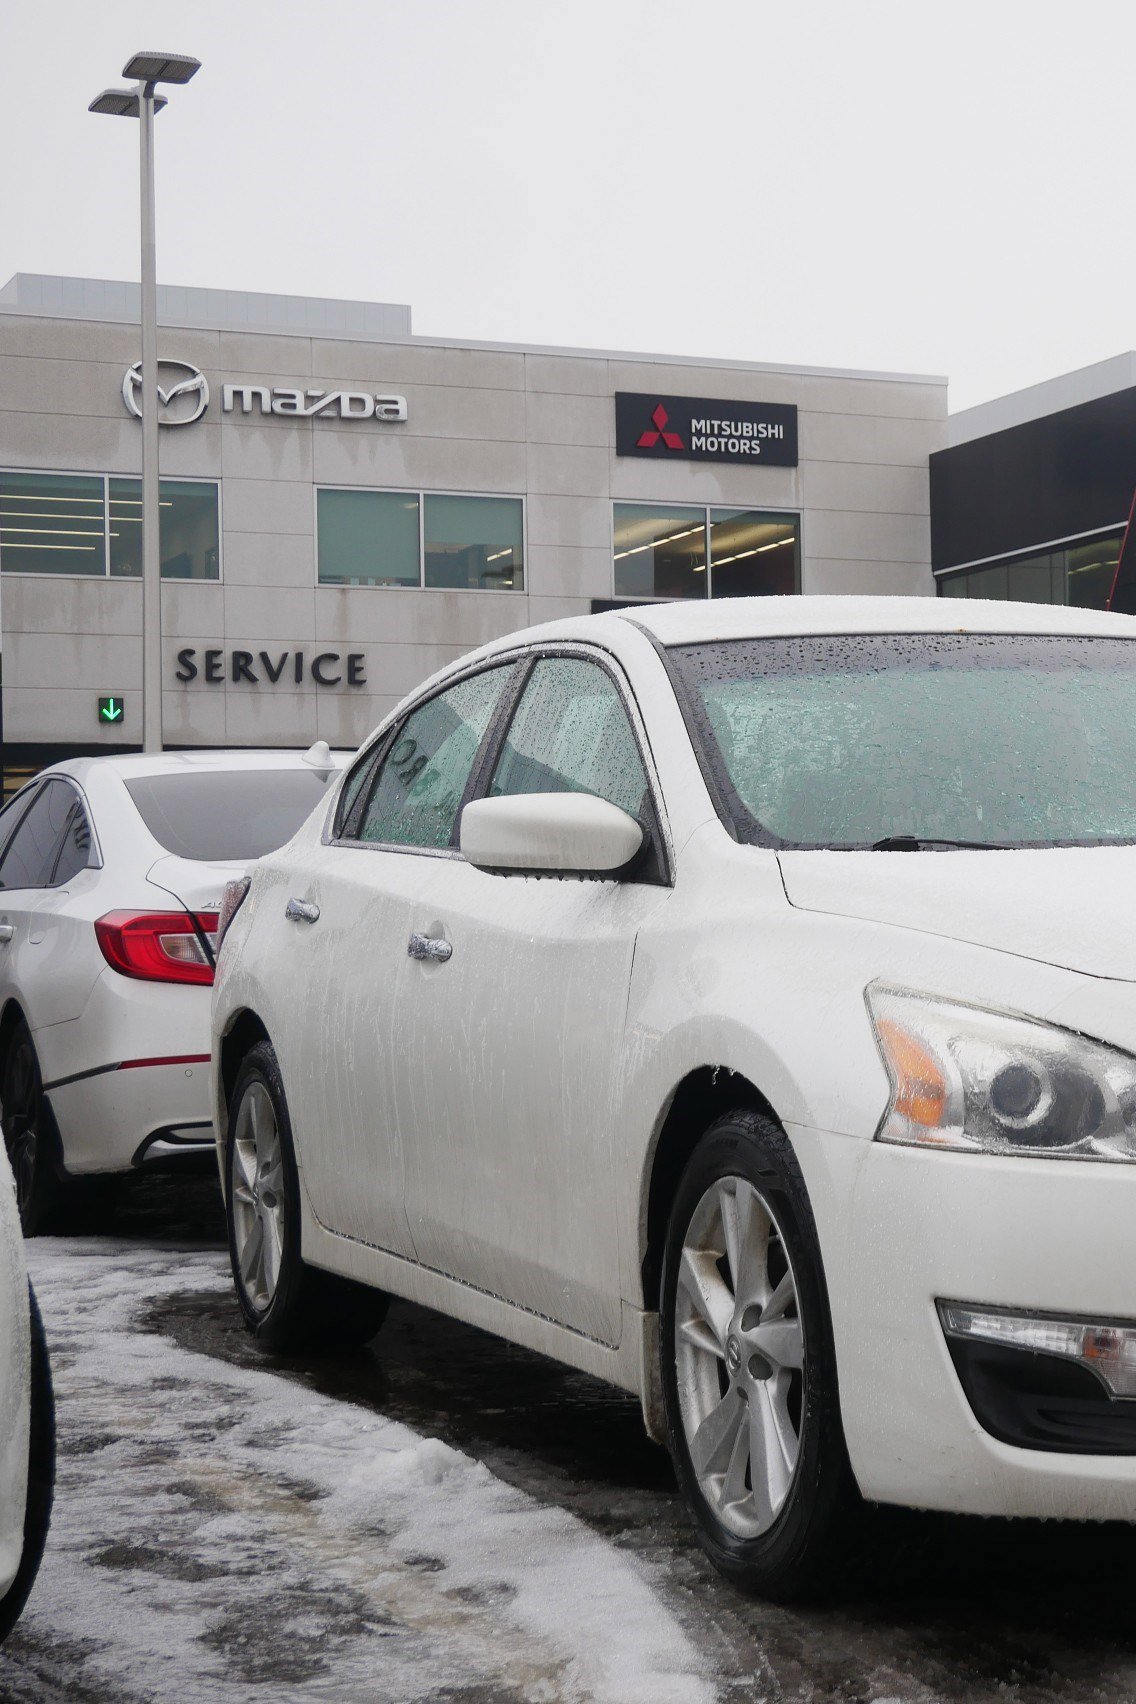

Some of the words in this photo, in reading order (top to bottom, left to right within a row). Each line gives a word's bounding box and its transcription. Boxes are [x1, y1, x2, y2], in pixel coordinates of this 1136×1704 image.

[691, 418, 784, 440] MITSUBISHI
[691, 436, 761, 455] MOTORS
[175, 648, 367, 686] SERVICE
